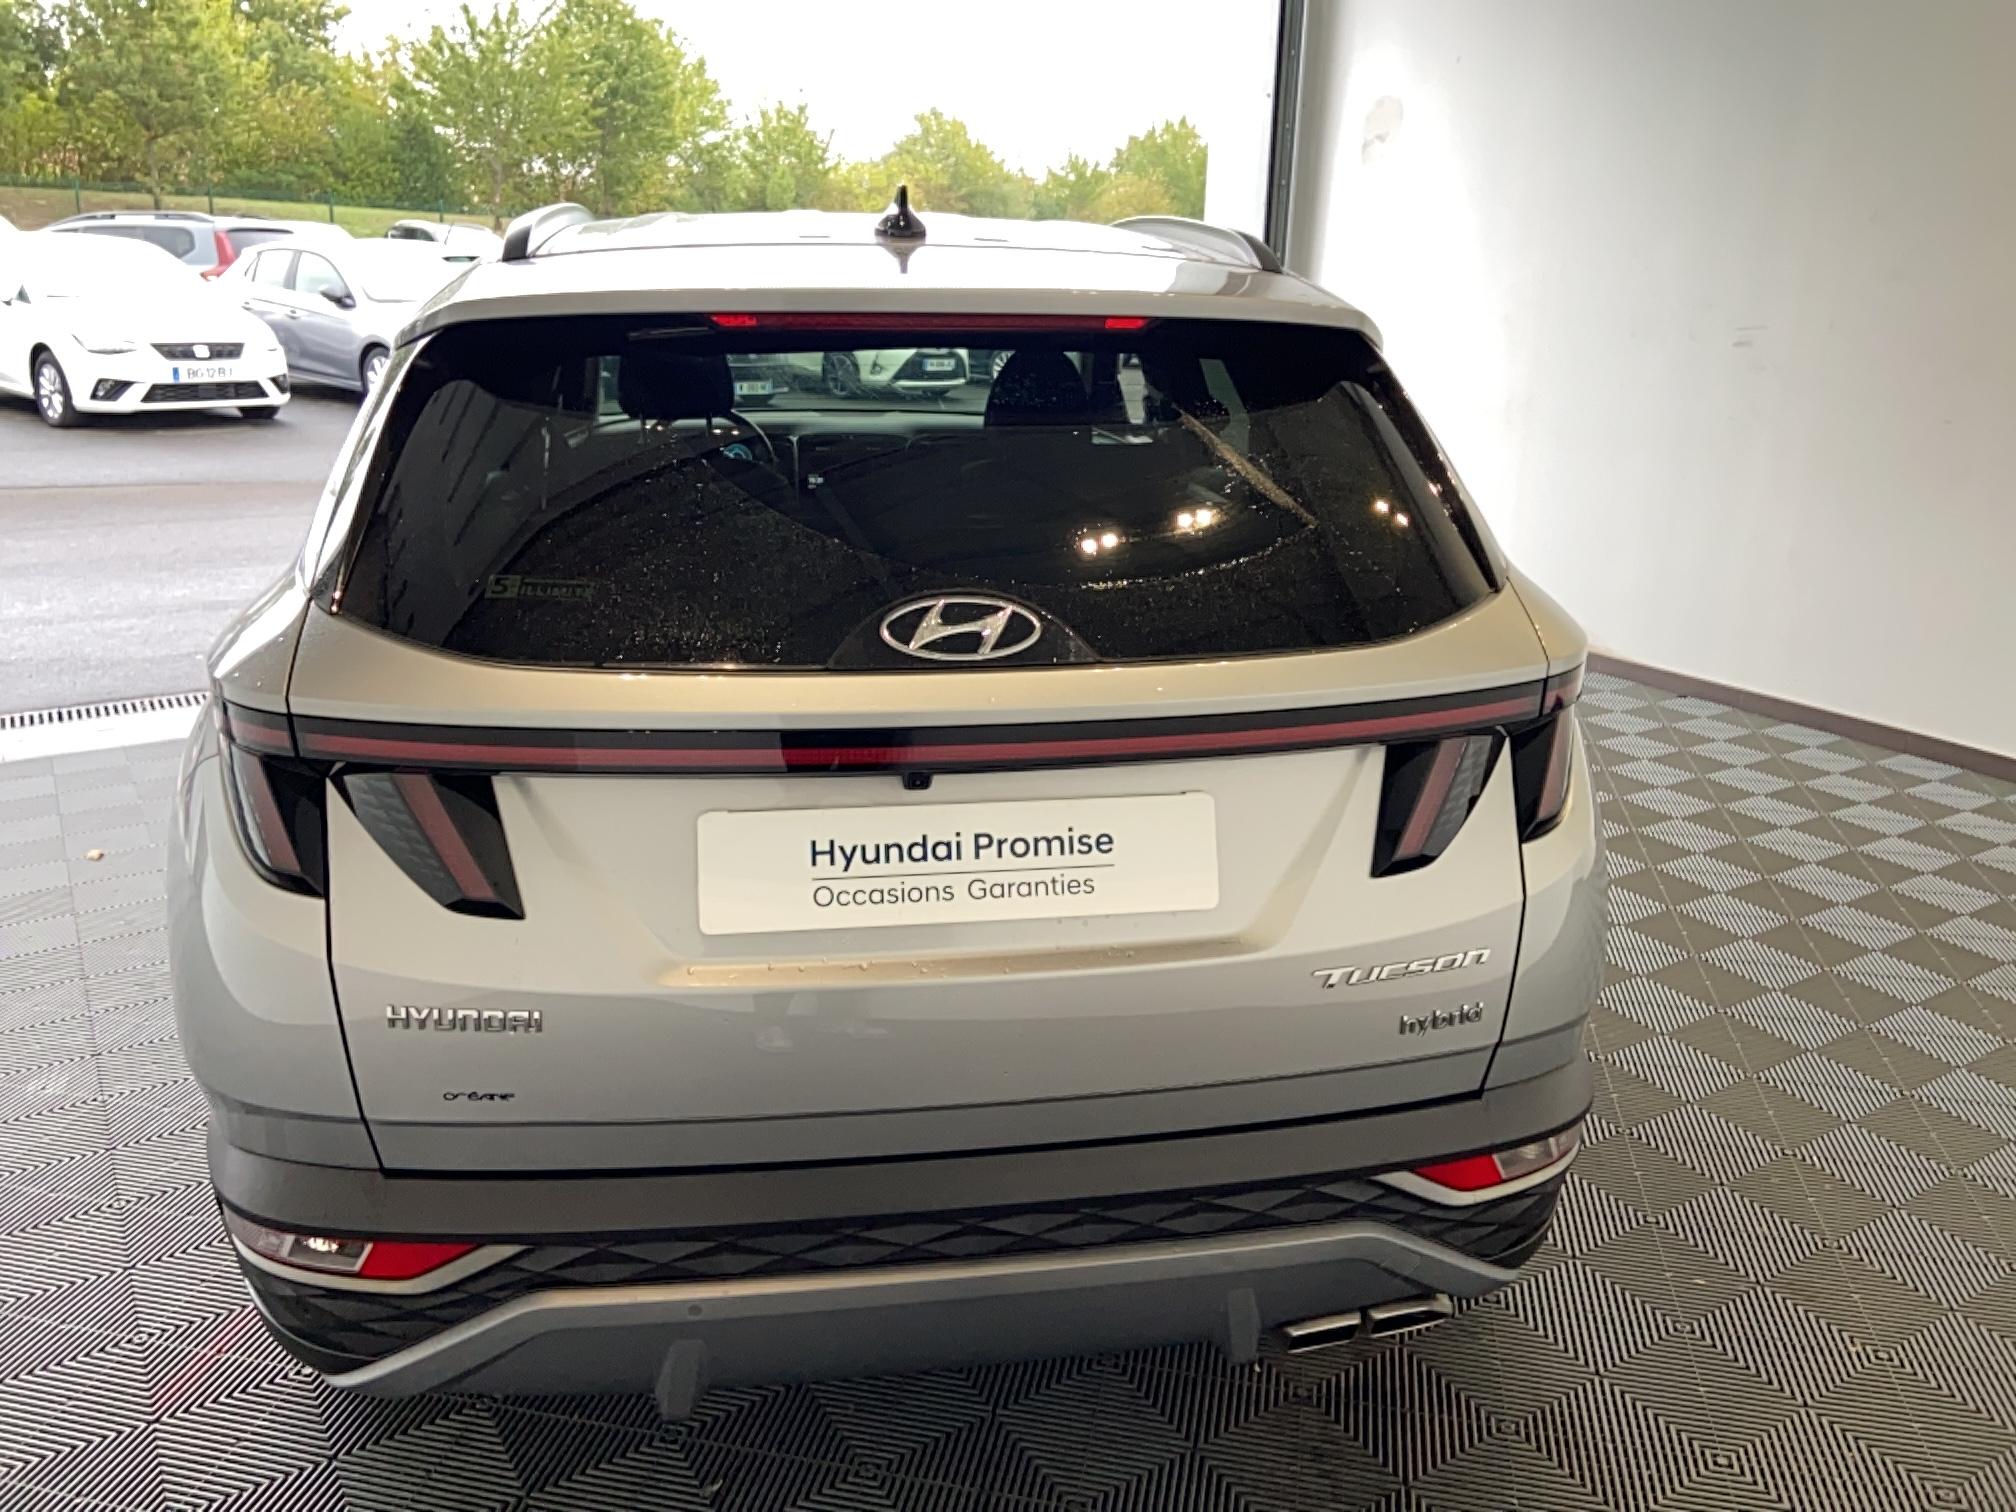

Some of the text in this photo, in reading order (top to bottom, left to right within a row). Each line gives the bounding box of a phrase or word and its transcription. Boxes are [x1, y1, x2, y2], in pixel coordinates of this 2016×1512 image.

[810, 827, 1114, 872] Hyundai Promise
[813, 873, 1095, 908] Occasions Garanties
[386, 1004, 543, 1033] HYUNDAI
[1399, 1001, 1485, 1036] hybrid
